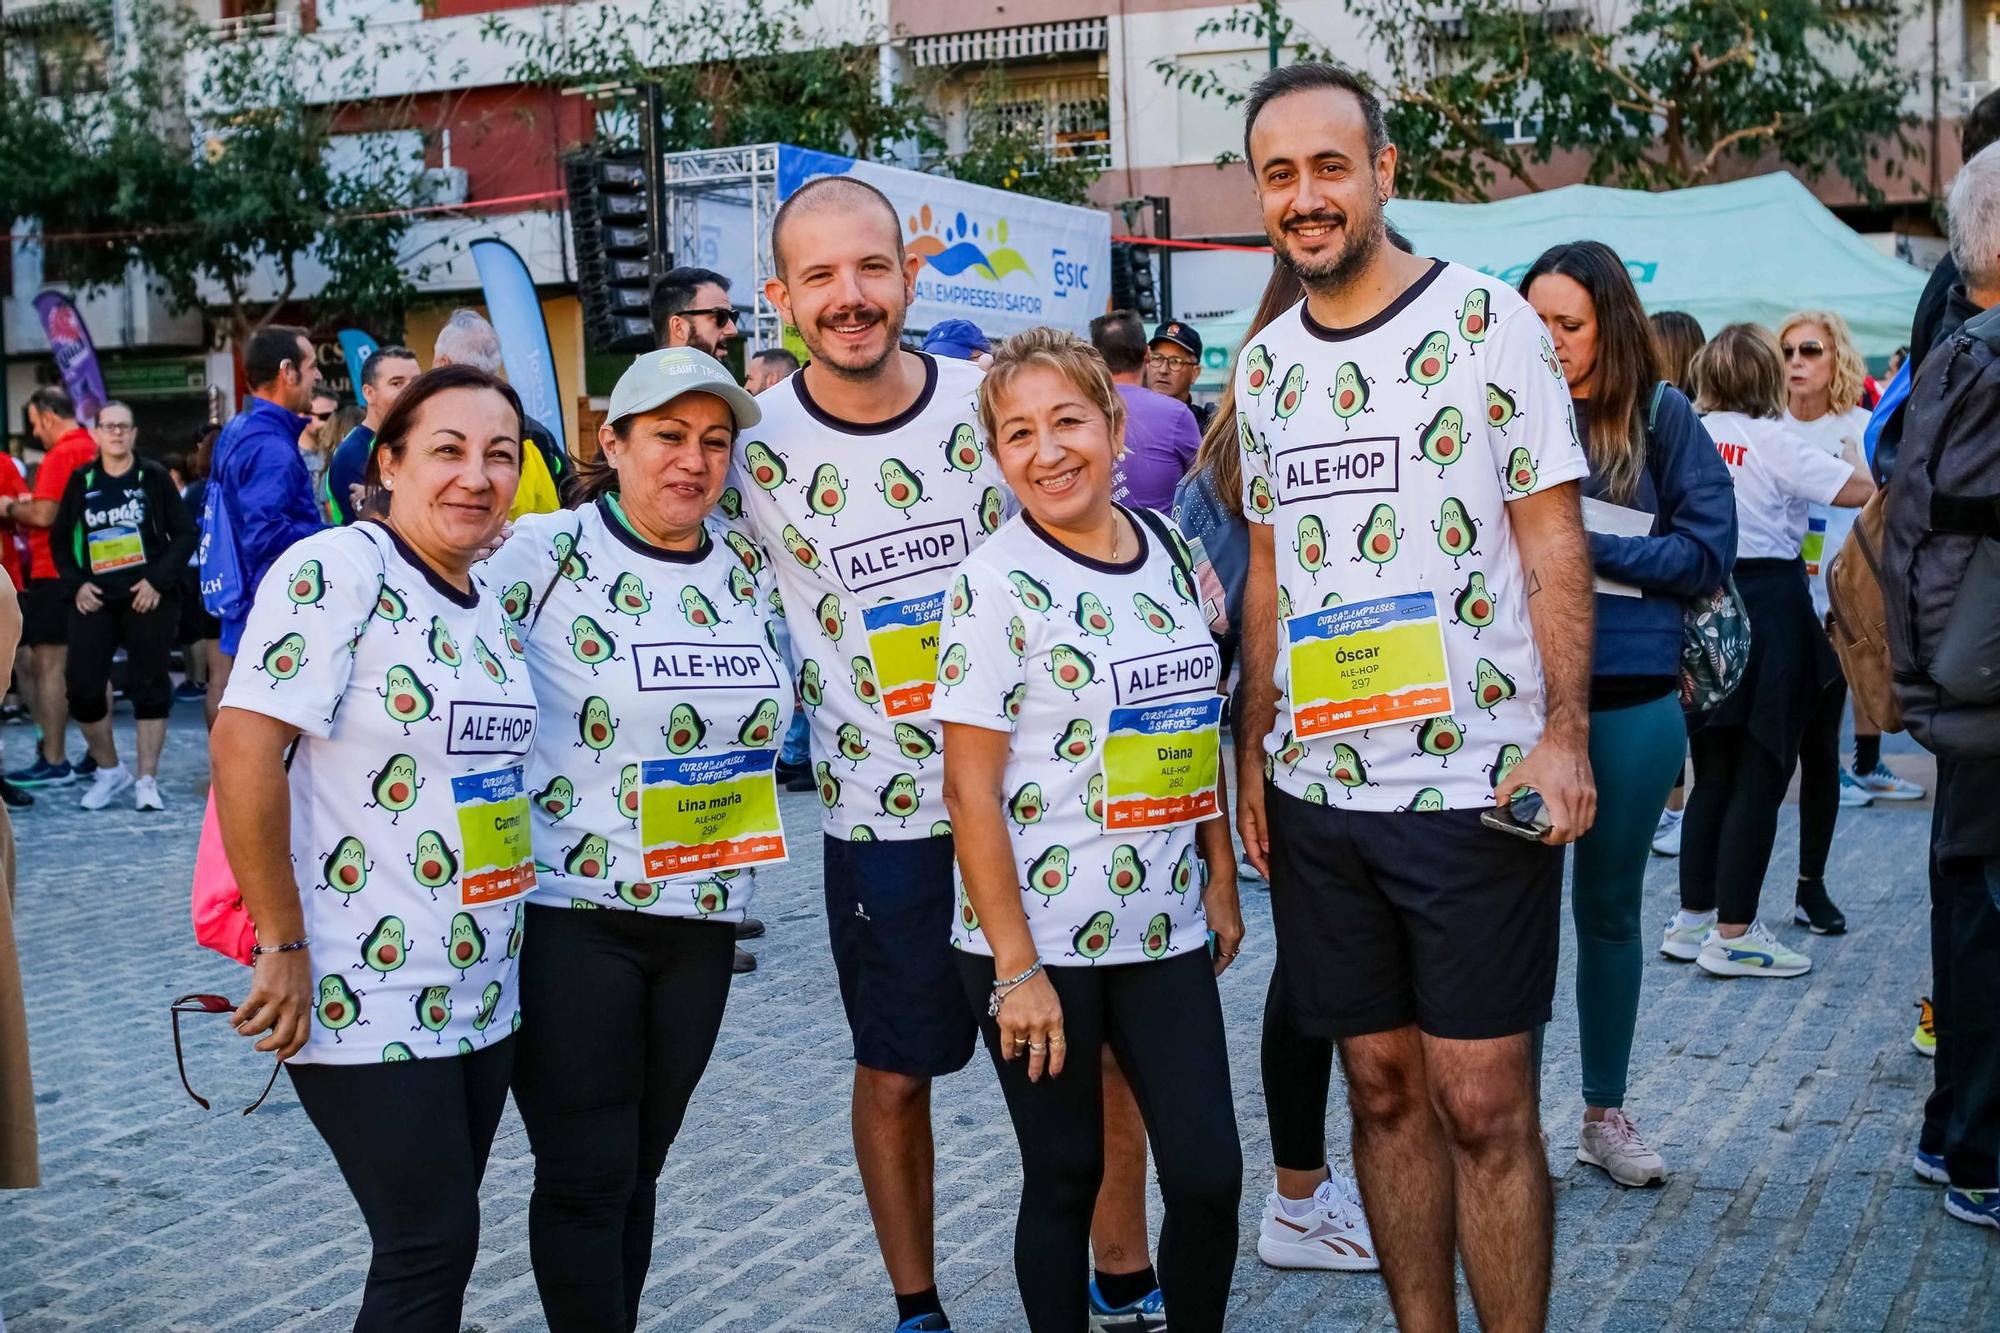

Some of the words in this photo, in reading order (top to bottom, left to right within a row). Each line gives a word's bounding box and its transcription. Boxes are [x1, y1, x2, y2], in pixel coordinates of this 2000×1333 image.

[936, 283, 998, 309] EMPRESES
[1005, 293, 1043, 315] SAFOR
[1286, 451, 1385, 490] ALE-HOP
[85, 508, 107, 528] be
[850, 533, 955, 580] ALE-HOP
[901, 599, 934, 615] CURSA
[923, 607, 942, 621] SAF
[1317, 611, 1344, 627] CURSA
[1351, 602, 1396, 618] EMPRESES
[1333, 620, 1364, 635] SAFOR
[1335, 645, 1381, 664] Óscar
[652, 654, 761, 678] ALE-HOP
[1340, 664, 1380, 679] ALE-HOP
[1129, 655, 1214, 694] ALE-HOP
[1351, 677, 1371, 690] 297
[1140, 710, 1168, 721] CURSA
[459, 715, 533, 743] ALE-HOP
[1155, 719, 1186, 731] SAFOR
[1157, 746, 1193, 762] Diana
[678, 761, 709, 773] CURSA
[1161, 765, 1191, 776] ALE-HOP
[1169, 777, 1184, 788] 282
[678, 799, 706, 813] Lina
[695, 812, 727, 825] ALE-HOP
